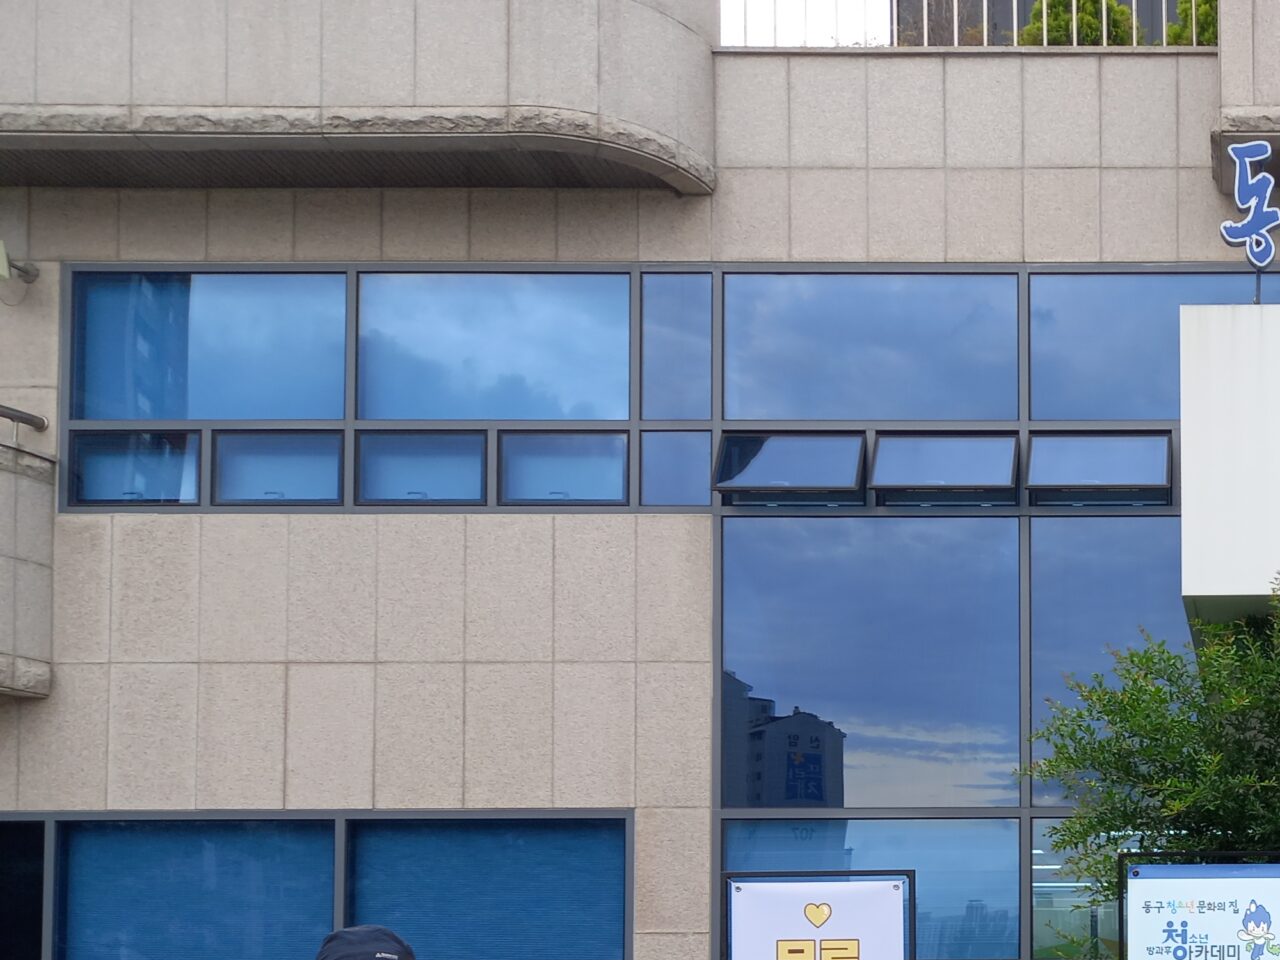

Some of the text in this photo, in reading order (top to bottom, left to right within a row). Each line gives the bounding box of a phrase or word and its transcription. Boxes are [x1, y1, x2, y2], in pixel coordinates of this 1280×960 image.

[1142, 899, 1239, 915] 동구 청소년 문화의 집
[1146, 944, 1240, 960] 방과후 아카데미
